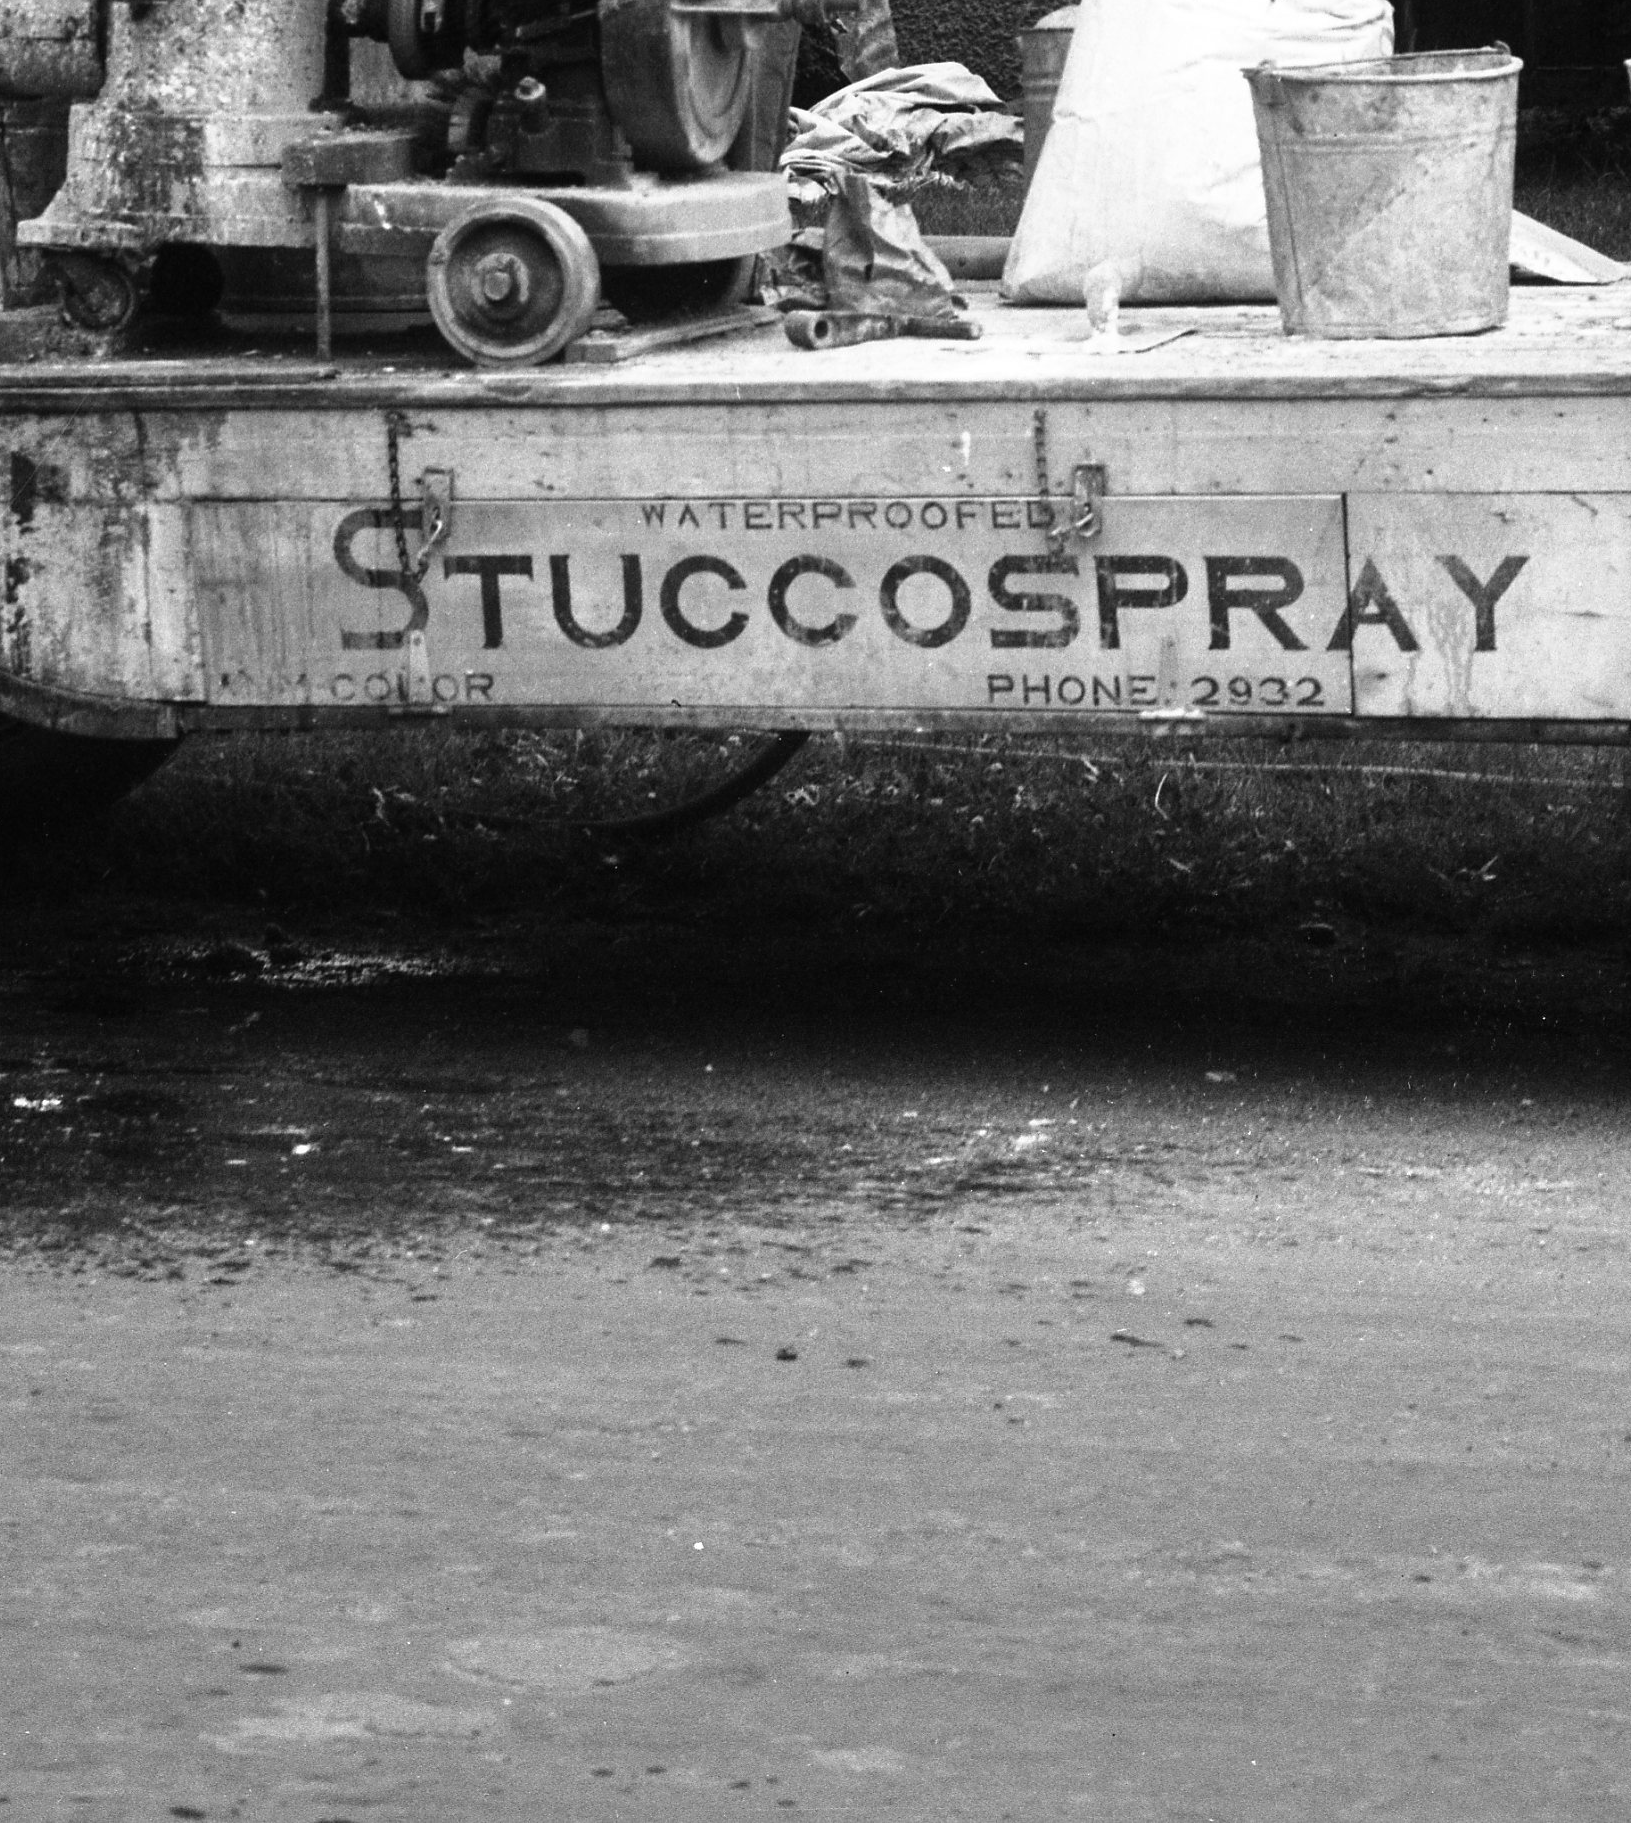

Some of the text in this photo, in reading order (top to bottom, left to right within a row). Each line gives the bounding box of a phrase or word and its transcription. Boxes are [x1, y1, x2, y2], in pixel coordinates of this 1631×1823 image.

[641, 500, 1056, 530] WATERPROOFED
[332, 508, 1531, 652] STUCCOSPRAY
[1190, 676, 1326, 707] 2932
